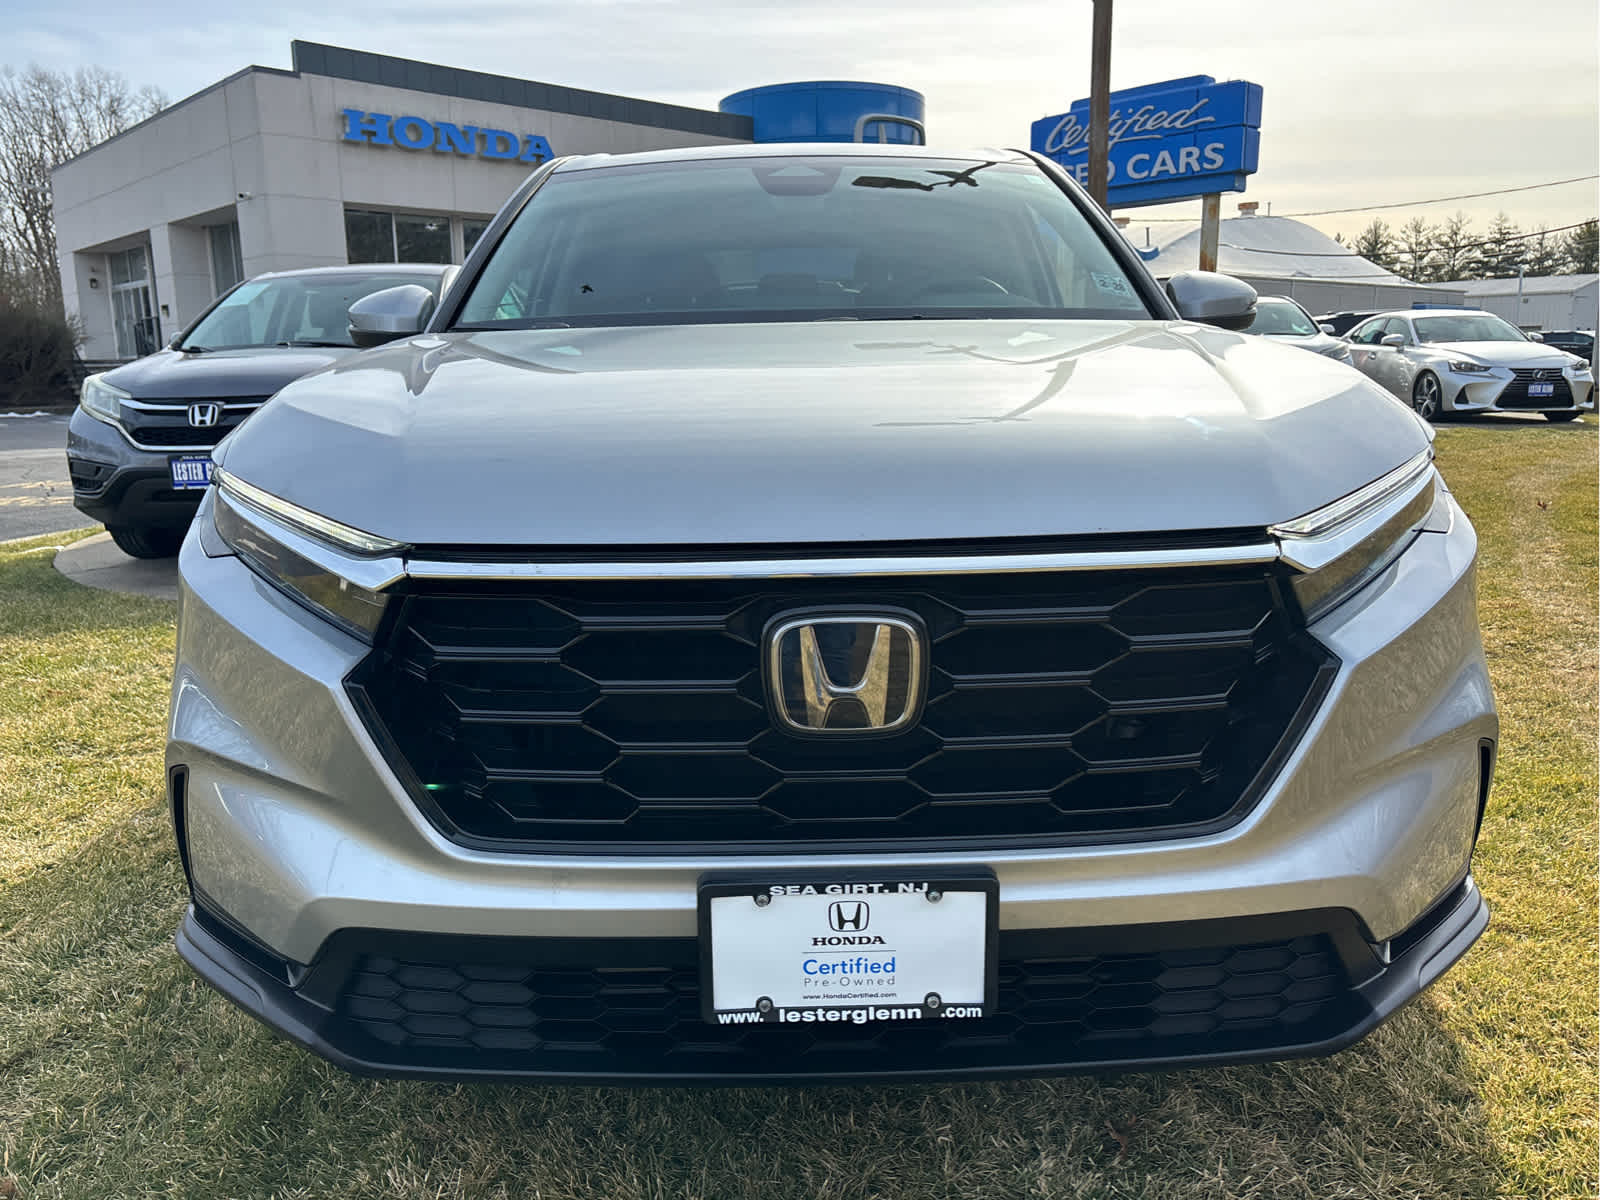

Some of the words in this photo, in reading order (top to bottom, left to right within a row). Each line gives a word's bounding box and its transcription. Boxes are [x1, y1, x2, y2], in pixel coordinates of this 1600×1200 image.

[1045, 98, 1216, 154] Cetified
[342, 108, 555, 164] HONDA
[1126, 143, 1225, 180] CARS
[172, 462, 204, 481] LESTER
[769, 885, 818, 896] SEA
[897, 882, 929, 894] NJ
[812, 936, 886, 946] HONDA
[802, 957, 896, 975] Certified
[803, 976, 896, 987] Pre-Owned
[802, 992, 897, 1000] www.HondaCertified.com
[717, 1011, 764, 1024] www.
[779, 1006, 922, 1025] lesterglenn
[940, 1006, 982, 1018] .com
